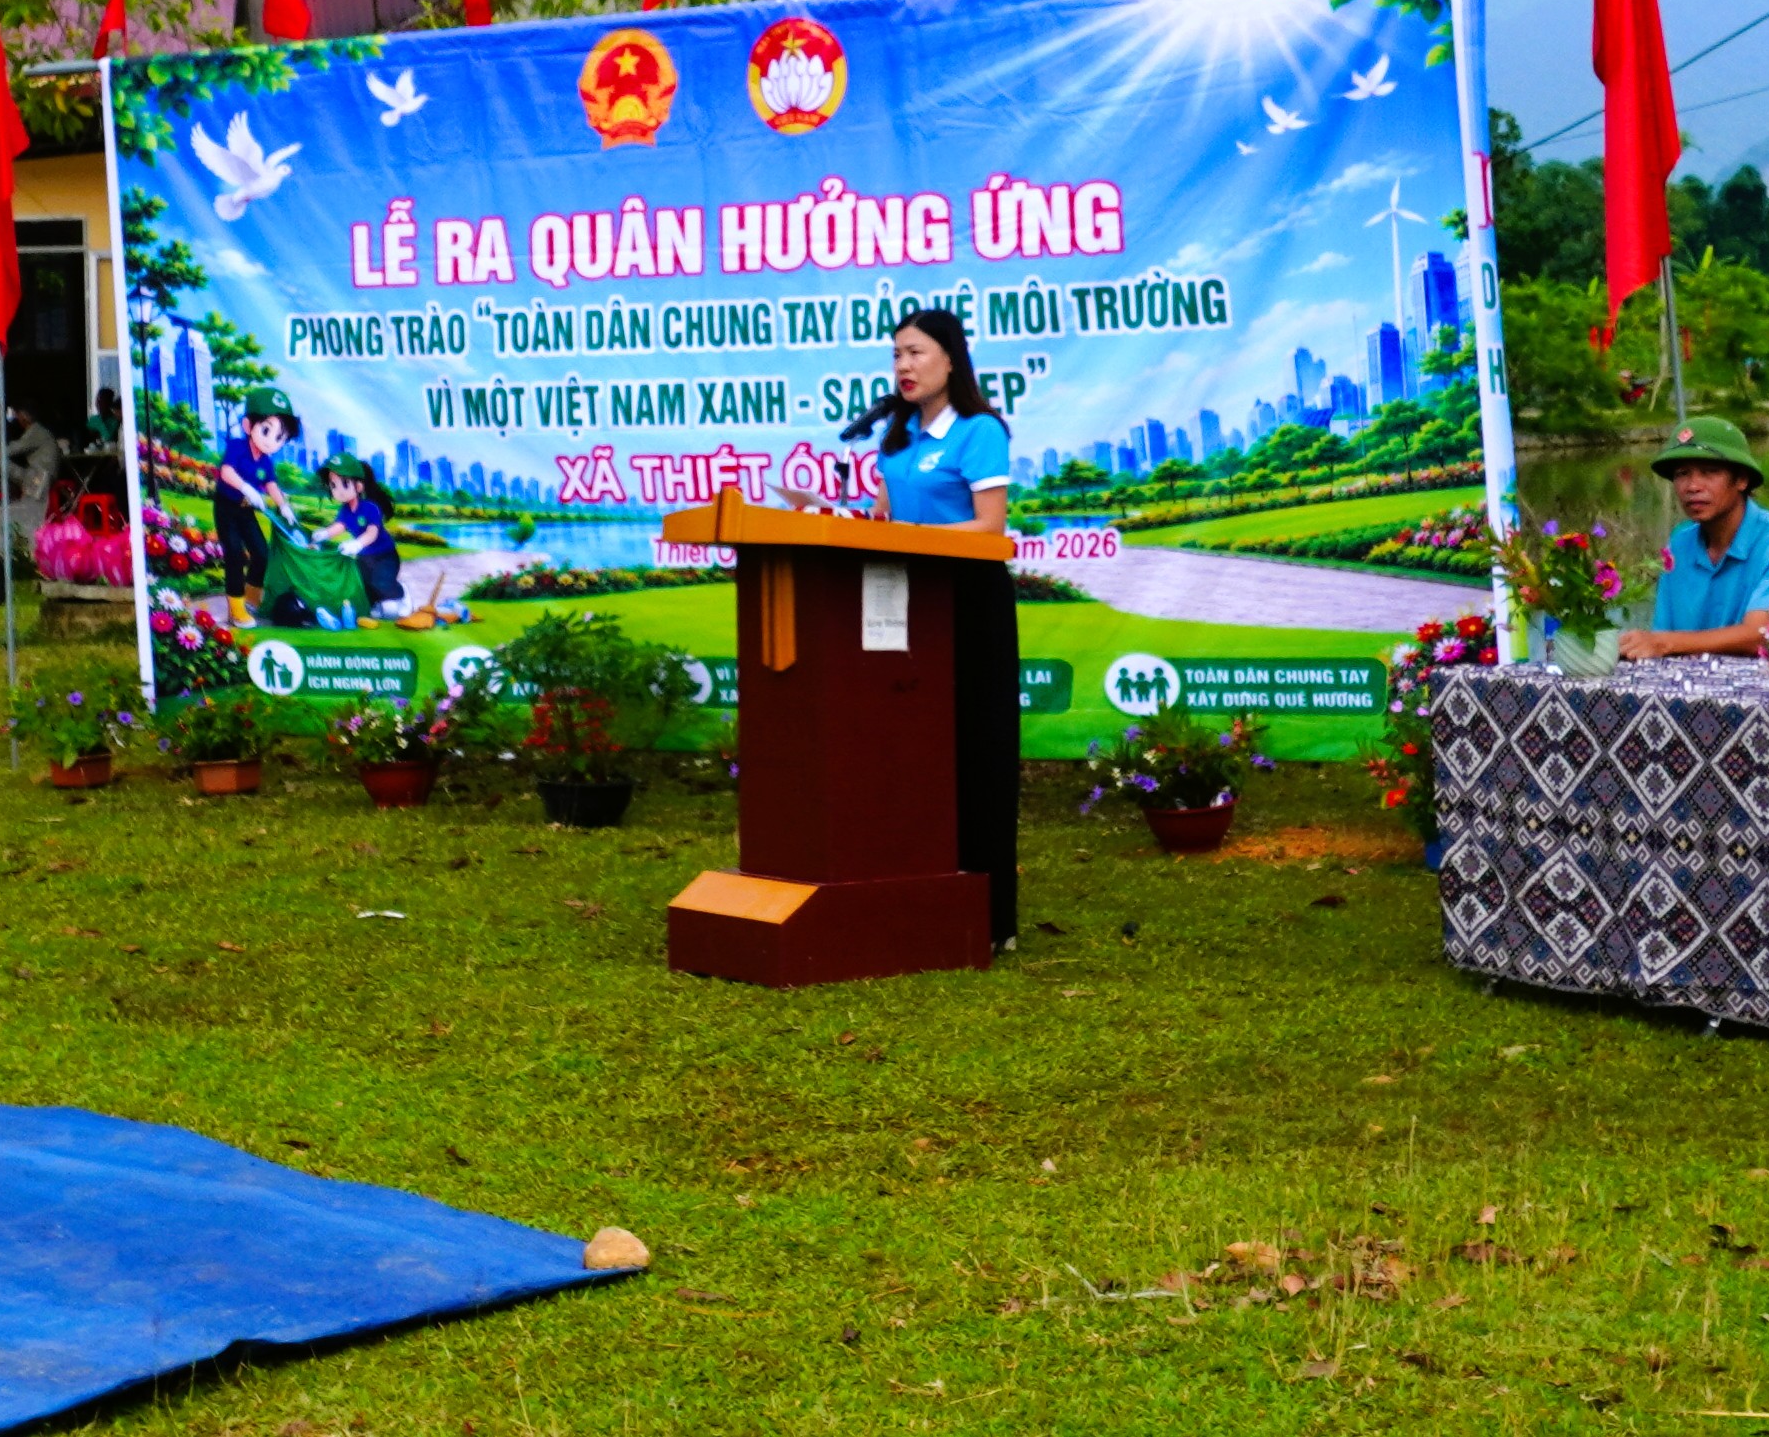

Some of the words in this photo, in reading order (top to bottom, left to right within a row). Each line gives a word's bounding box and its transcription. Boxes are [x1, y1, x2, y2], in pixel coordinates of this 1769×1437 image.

[351, 197, 418, 288] LỄ
[435, 217, 515, 284] RA
[530, 195, 704, 288] QUÂN
[718, 176, 953, 273] HƯỞNG
[972, 172, 1124, 262] ỨNG
[290, 317, 383, 357] PHONG
[392, 305, 466, 354] TRÀO
[586, 300, 650, 350] DÂN
[663, 303, 771, 348] CHUNG
[784, 300, 837, 342] TAY
[989, 280, 1059, 334] MÔI
[1072, 271, 1227, 328] TRƯỜNG
[428, 380, 454, 428] VÌ
[464, 379, 524, 436] MỘT
[536, 378, 598, 436] VIỆT
[611, 384, 685, 425] NAM
[699, 380, 785, 424] XANH
[556, 443, 626, 503] XÃ
[630, 442, 771, 503] THIẾT
[1056, 531, 1117, 559] 2026
[1184, 666, 1230, 684] TOÀN
[1233, 665, 1270, 684] DÂN
[1274, 668, 1334, 685] CHUNG
[1338, 668, 1370, 685] TAY
[1187, 689, 1218, 707] XÂY
[1274, 689, 1308, 708] QUÊ
